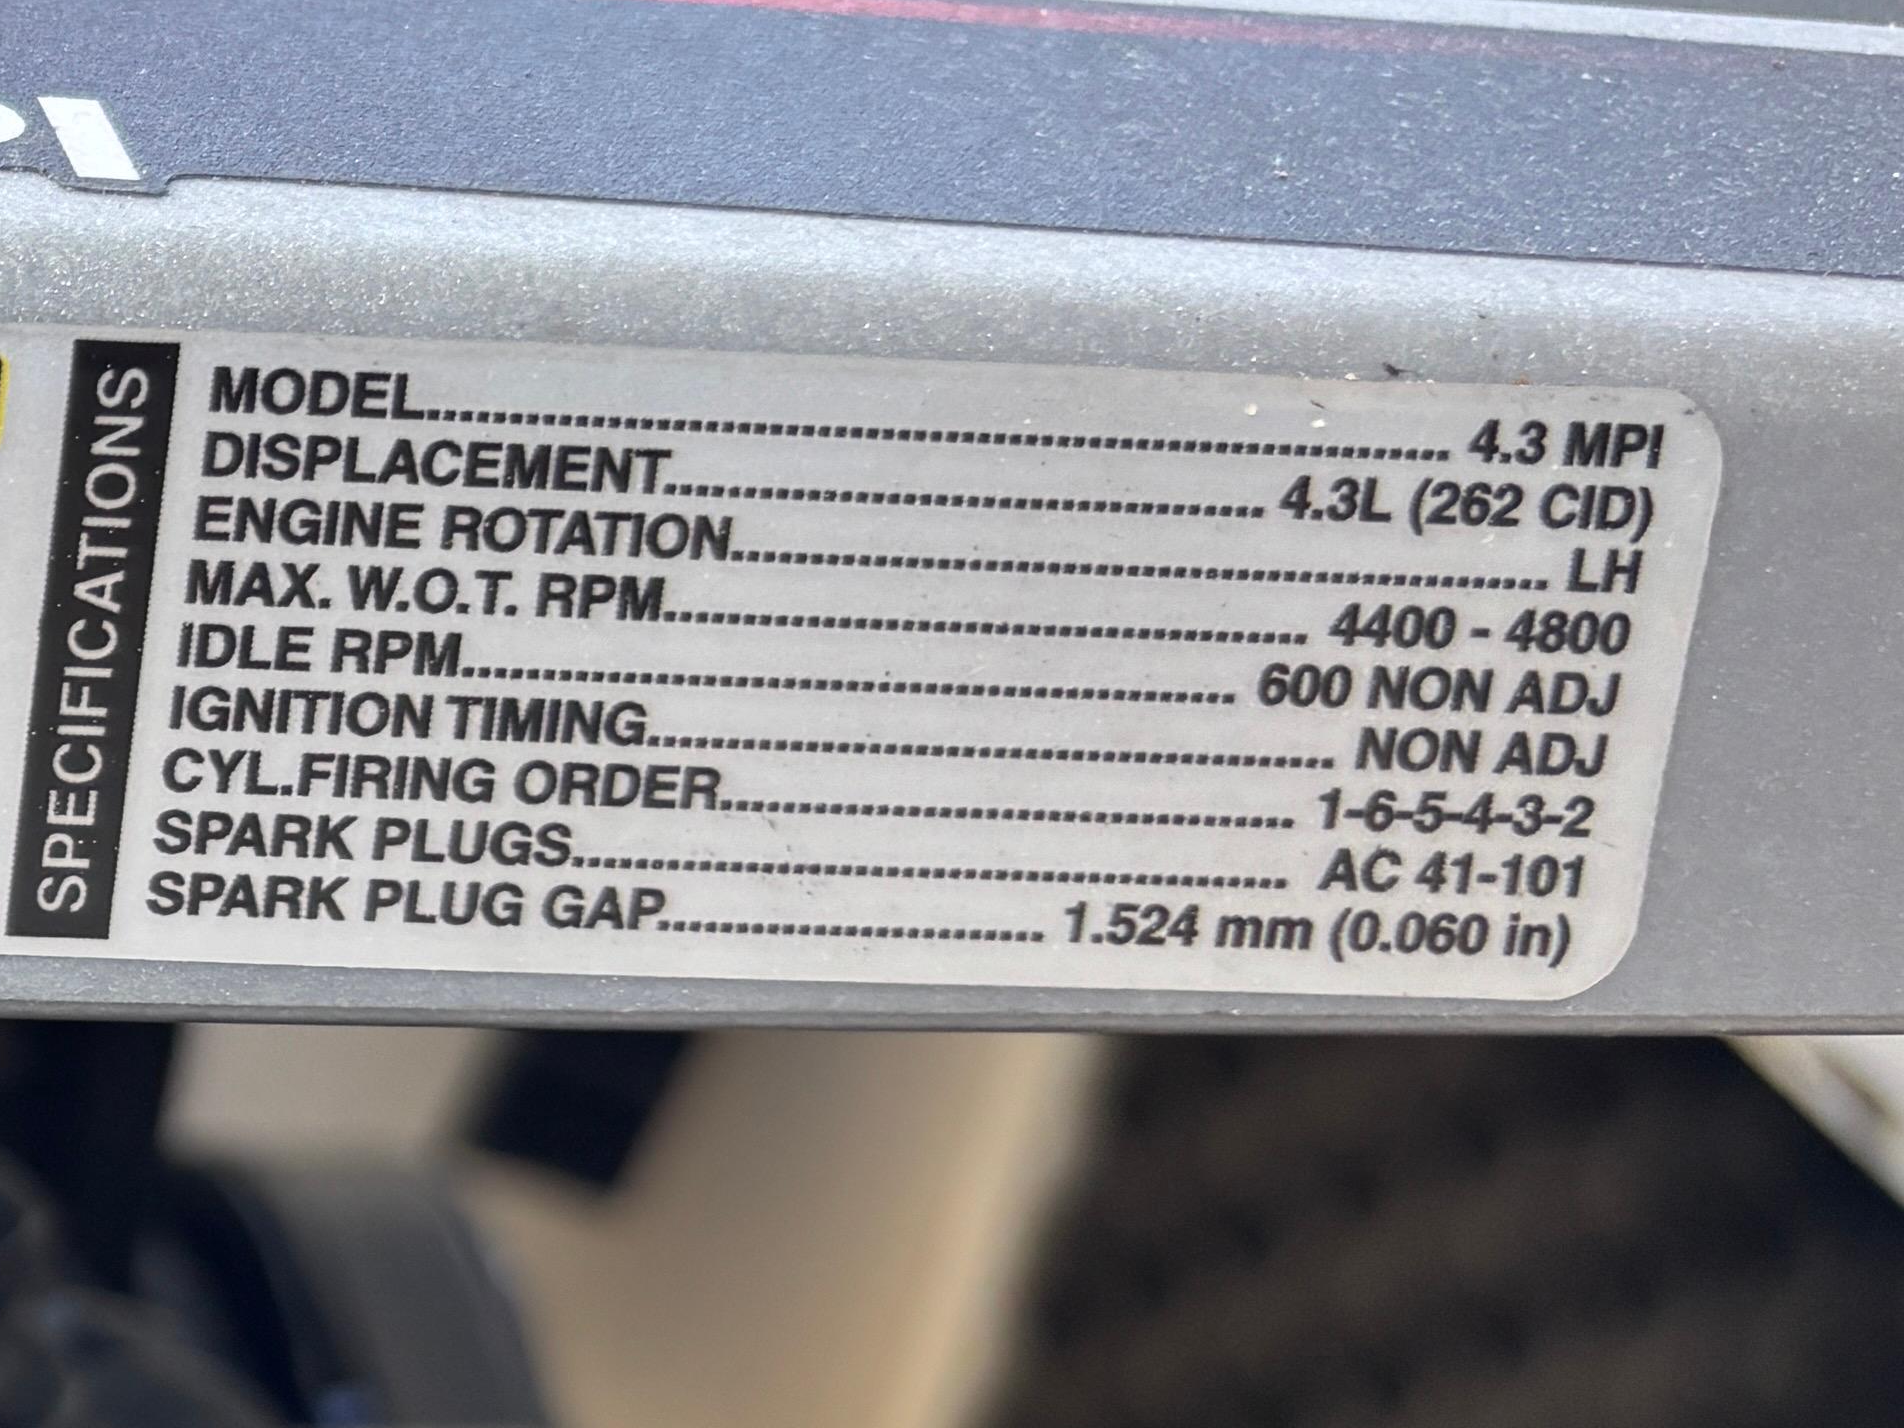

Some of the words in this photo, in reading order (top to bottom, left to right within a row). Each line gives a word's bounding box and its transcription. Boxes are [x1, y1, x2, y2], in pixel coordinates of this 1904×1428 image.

[209, 367, 425, 422] MODEL
[1469, 422, 1546, 466] 4.3
[1563, 423, 1666, 470] MPI
[202, 432, 671, 493] DISPLACEMENT
[1279, 476, 1393, 523] 4.3L
[1410, 480, 1521, 535] (262
[1538, 484, 1654, 542] CID)
[192, 496, 422, 550] ENGINE
[441, 505, 733, 561] ROTATION
[1567, 549, 1643, 594] LH
[37, 367, 148, 914] SPECIFICATIONS
[185, 558, 331, 612] MAX.
[351, 567, 519, 617] W.O.T.
[536, 574, 664, 621] RPM
[1328, 603, 1456, 648] 4400
[1471, 628, 1490, 637] -
[1502, 610, 1630, 655] 4800
[176, 621, 313, 672] IDLE
[330, 627, 462, 678] RPM
[1258, 664, 1351, 708] 600
[1367, 667, 1491, 713] NON
[1505, 672, 1621, 717] ADJ
[168, 685, 432, 740] IGNITION
[448, 695, 647, 747] TIMING
[1355, 727, 1480, 774] NON
[1494, 733, 1608, 778] ADJ
[162, 748, 494, 806] CYL.FIRING
[512, 761, 721, 811] ORDER
[1318, 789, 1595, 838] 1-6-5-4-3-2
[152, 810, 358, 863] SPARK
[372, 817, 573, 869] PLUGS
[1317, 850, 1401, 893] AC
[1414, 854, 1585, 899] 41-101
[145, 870, 345, 922] SPARK
[362, 877, 524, 927] PLUG
[541, 886, 667, 932] GAP
[1064, 903, 1199, 948] 1.524
[1214, 916, 1313, 952] mm
[1328, 909, 1487, 965] (0.060
[1502, 914, 1571, 968] in)
